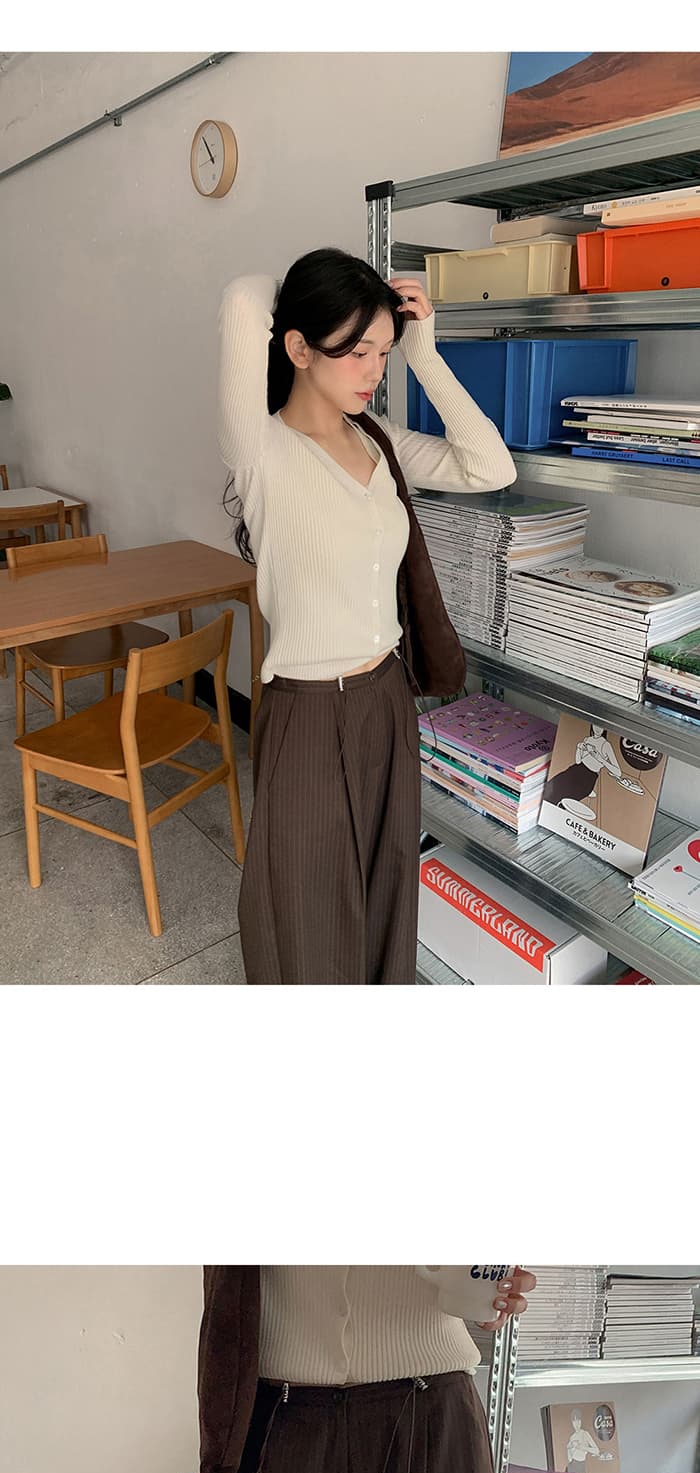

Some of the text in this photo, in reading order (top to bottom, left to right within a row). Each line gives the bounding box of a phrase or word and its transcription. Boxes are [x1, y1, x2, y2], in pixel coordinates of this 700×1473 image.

[565, 818, 617, 851] CAFE & BAKERY
[426, 866, 544, 958] SUMMERLAND
